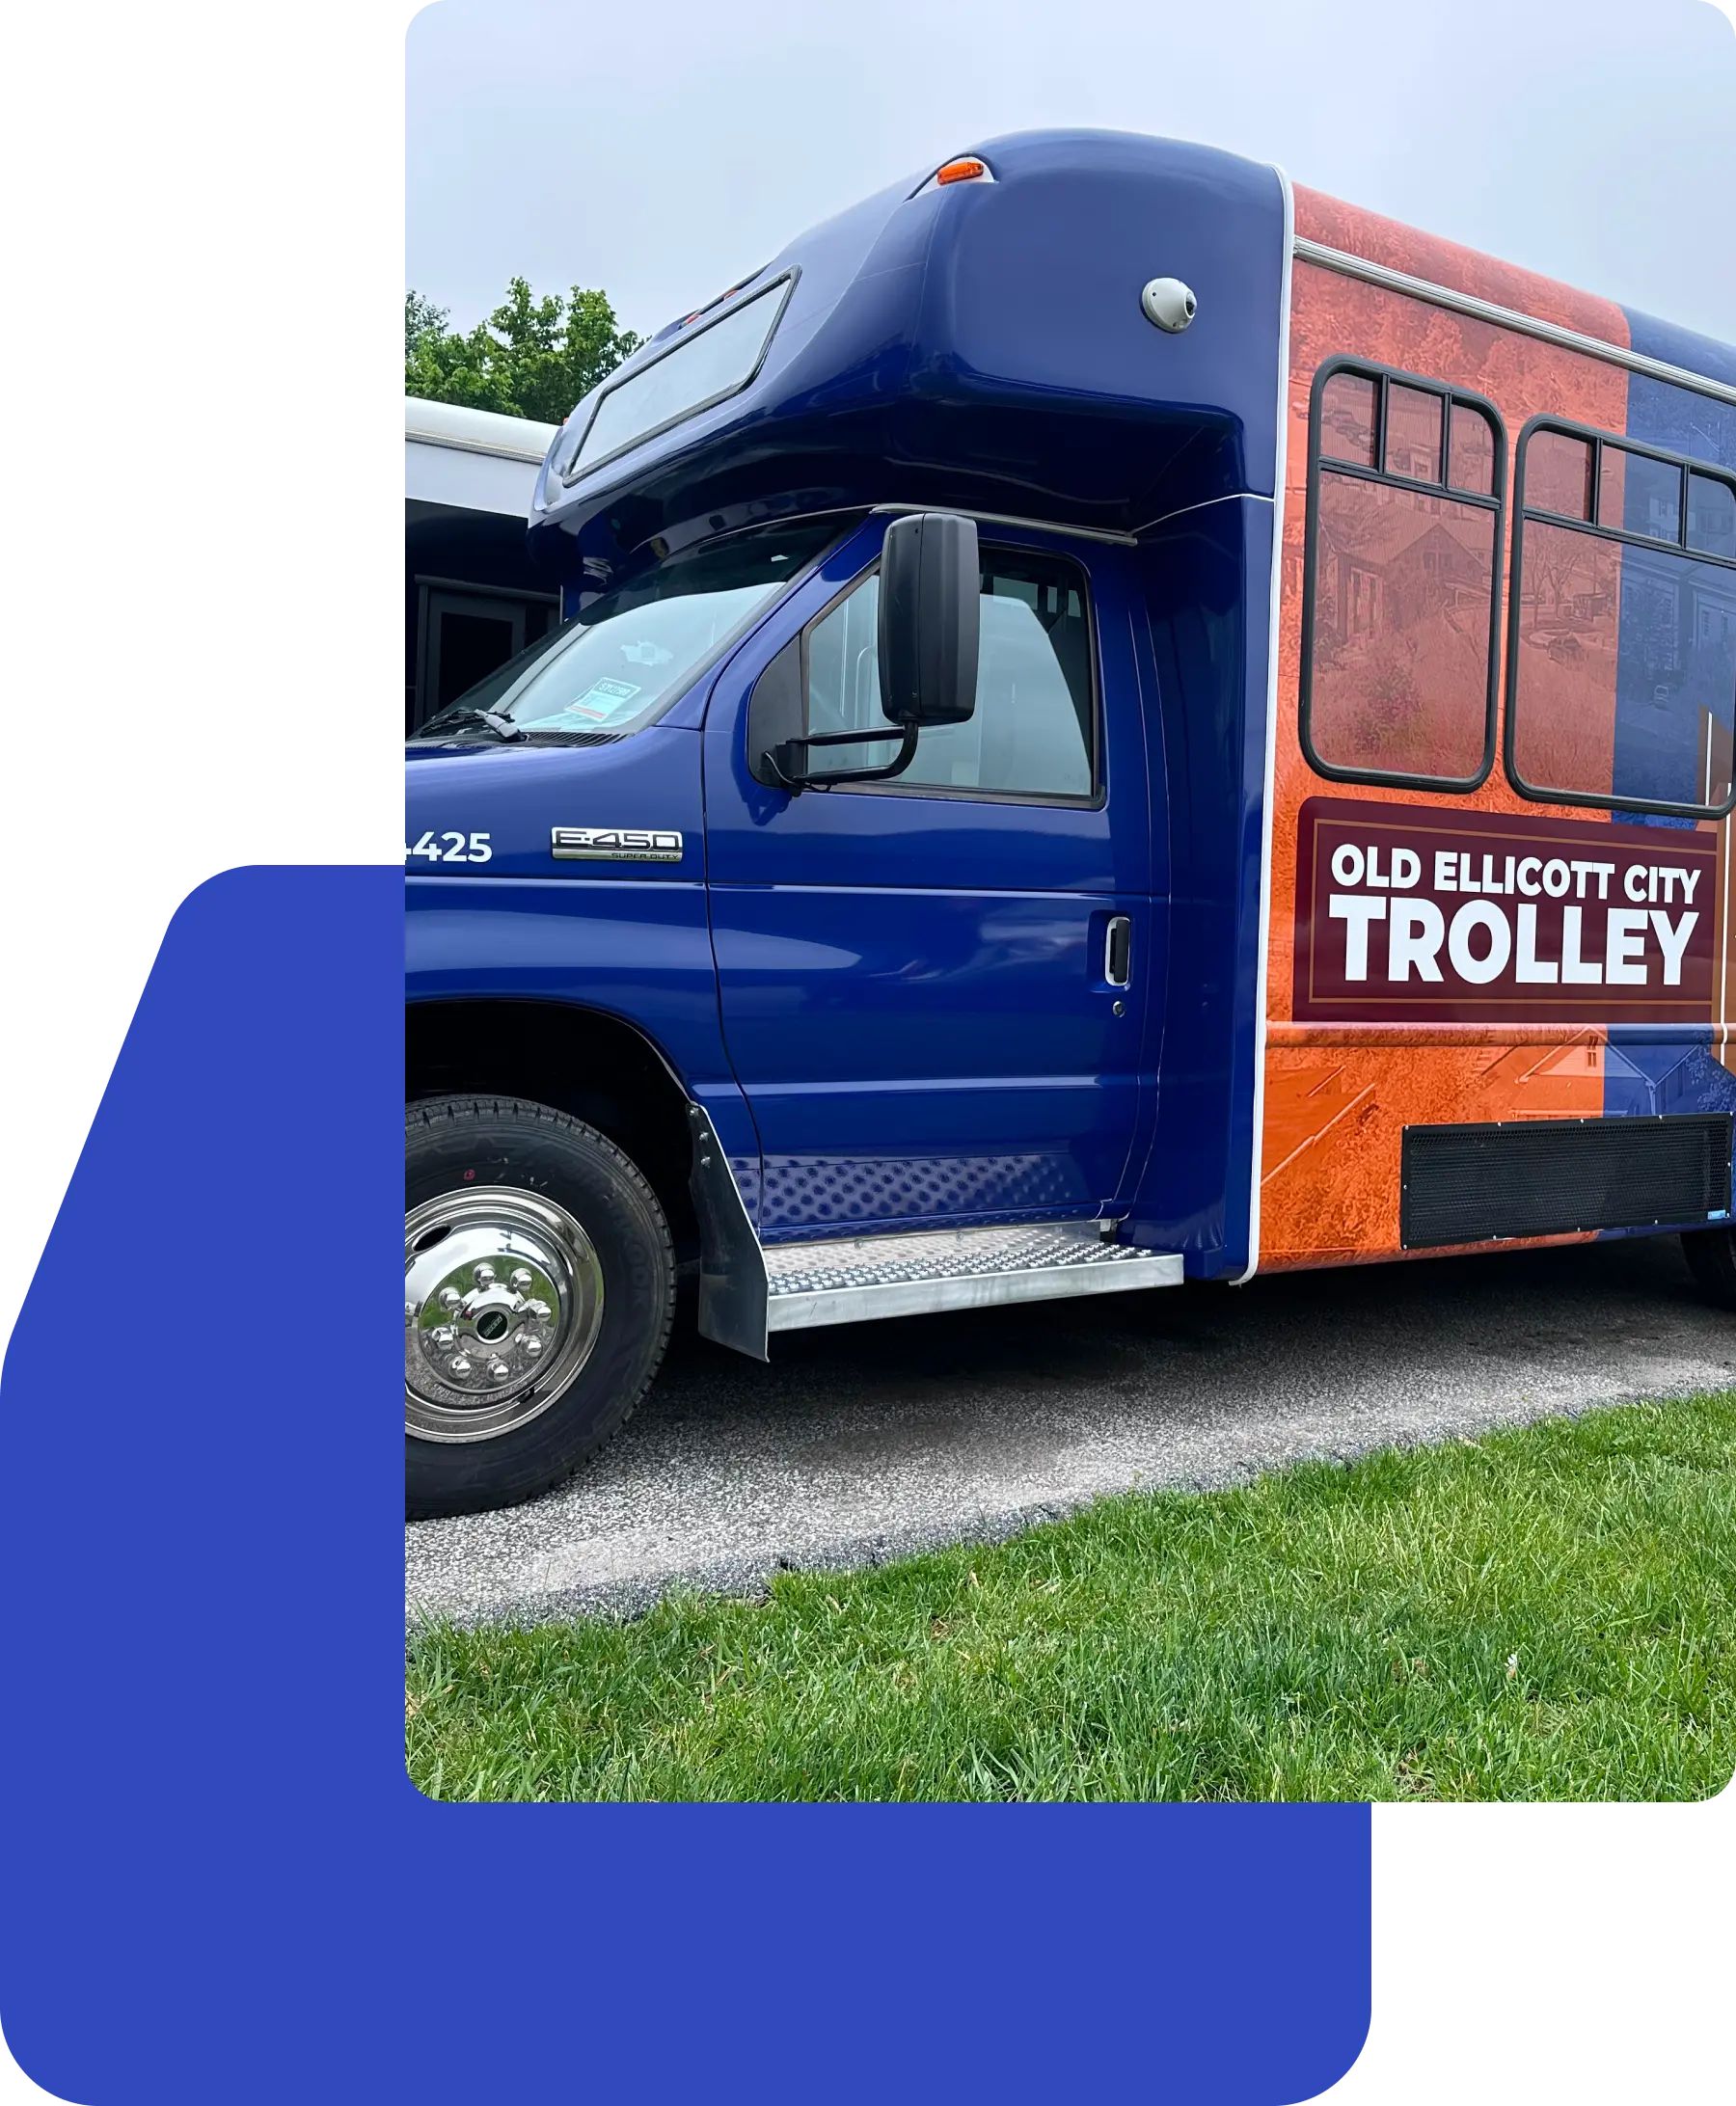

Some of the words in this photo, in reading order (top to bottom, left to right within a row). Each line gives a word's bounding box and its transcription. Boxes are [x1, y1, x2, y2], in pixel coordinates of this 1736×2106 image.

[556, 829, 680, 850] E-450
[1331, 844, 1422, 889] OLD
[1434, 850, 1615, 900] ELLICOTT
[1624, 864, 1702, 904] CITY
[1329, 894, 1700, 986] TROLLEY
